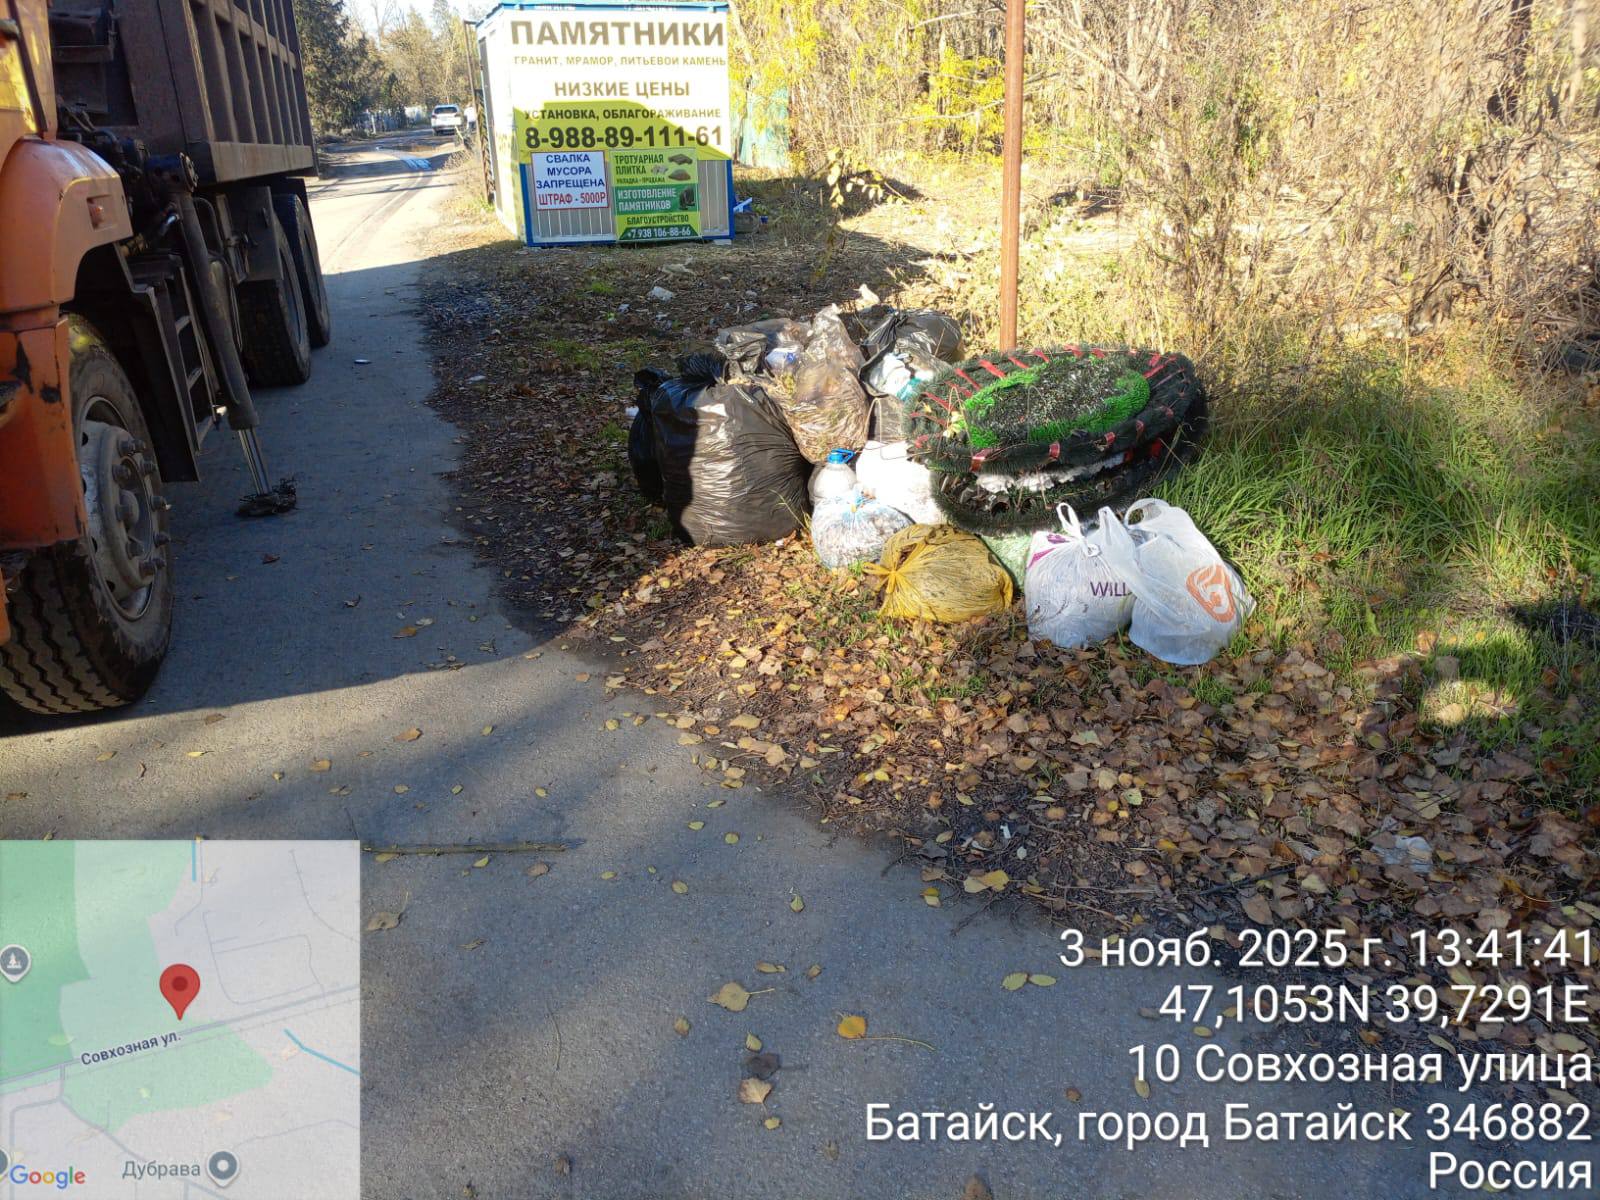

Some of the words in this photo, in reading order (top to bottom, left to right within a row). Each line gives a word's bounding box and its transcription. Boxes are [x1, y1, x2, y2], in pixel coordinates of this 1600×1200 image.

[510, 20, 724, 46] ПАМЯТНИКИ
[514, 56, 563, 67] ГРАНИТ,
[566, 56, 617, 67] МРАМОР,
[682, 56, 726, 66] КАМЕНЬ
[554, 82, 629, 97] НИЗКИЕ
[636, 82, 690, 99] ЦЕНЫ
[524, 109, 600, 121] УСТАНОВКА,
[603, 108, 722, 120] ОБЛАГОРАЖИВАНИЕ
[525, 125, 722, 149] 8-988-89-111-61
[545, 154, 591, 164] СВАЛКА
[614, 154, 664, 165] ТРОТУАРНАЯ
[547, 166, 592, 177] МУСОРА
[615, 165, 646, 175] ПЛИТКА
[536, 178, 605, 190] ЗАПРЕЩЕНА
[538, 193, 573, 205] ШТРАФ
[580, 192, 606, 204] 5000Р
[617, 188, 677, 200] ИЗГОТОВЛЕНИЕ
[618, 200, 671, 212] ПАМЯТНИКОВ
[627, 214, 689, 225] БЛАГОУСТРОЙСТВО
